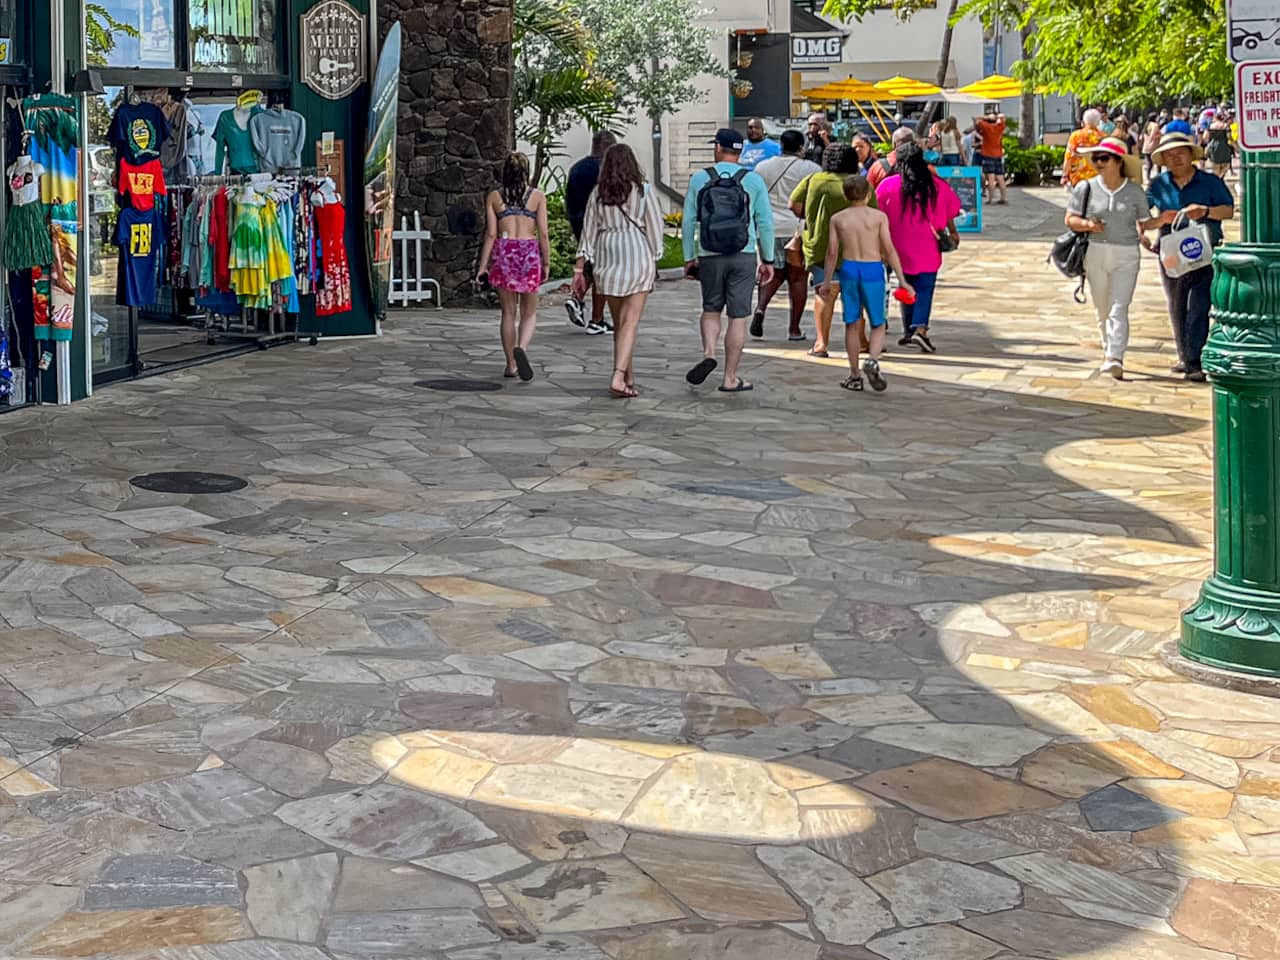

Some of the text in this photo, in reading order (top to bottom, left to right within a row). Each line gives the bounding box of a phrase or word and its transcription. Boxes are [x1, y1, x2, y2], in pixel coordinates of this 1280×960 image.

[310, 35, 359, 48] MELE
[793, 37, 840, 56] OMG
[1246, 108, 1267, 121] WITH
[130, 223, 152, 254] FBI
